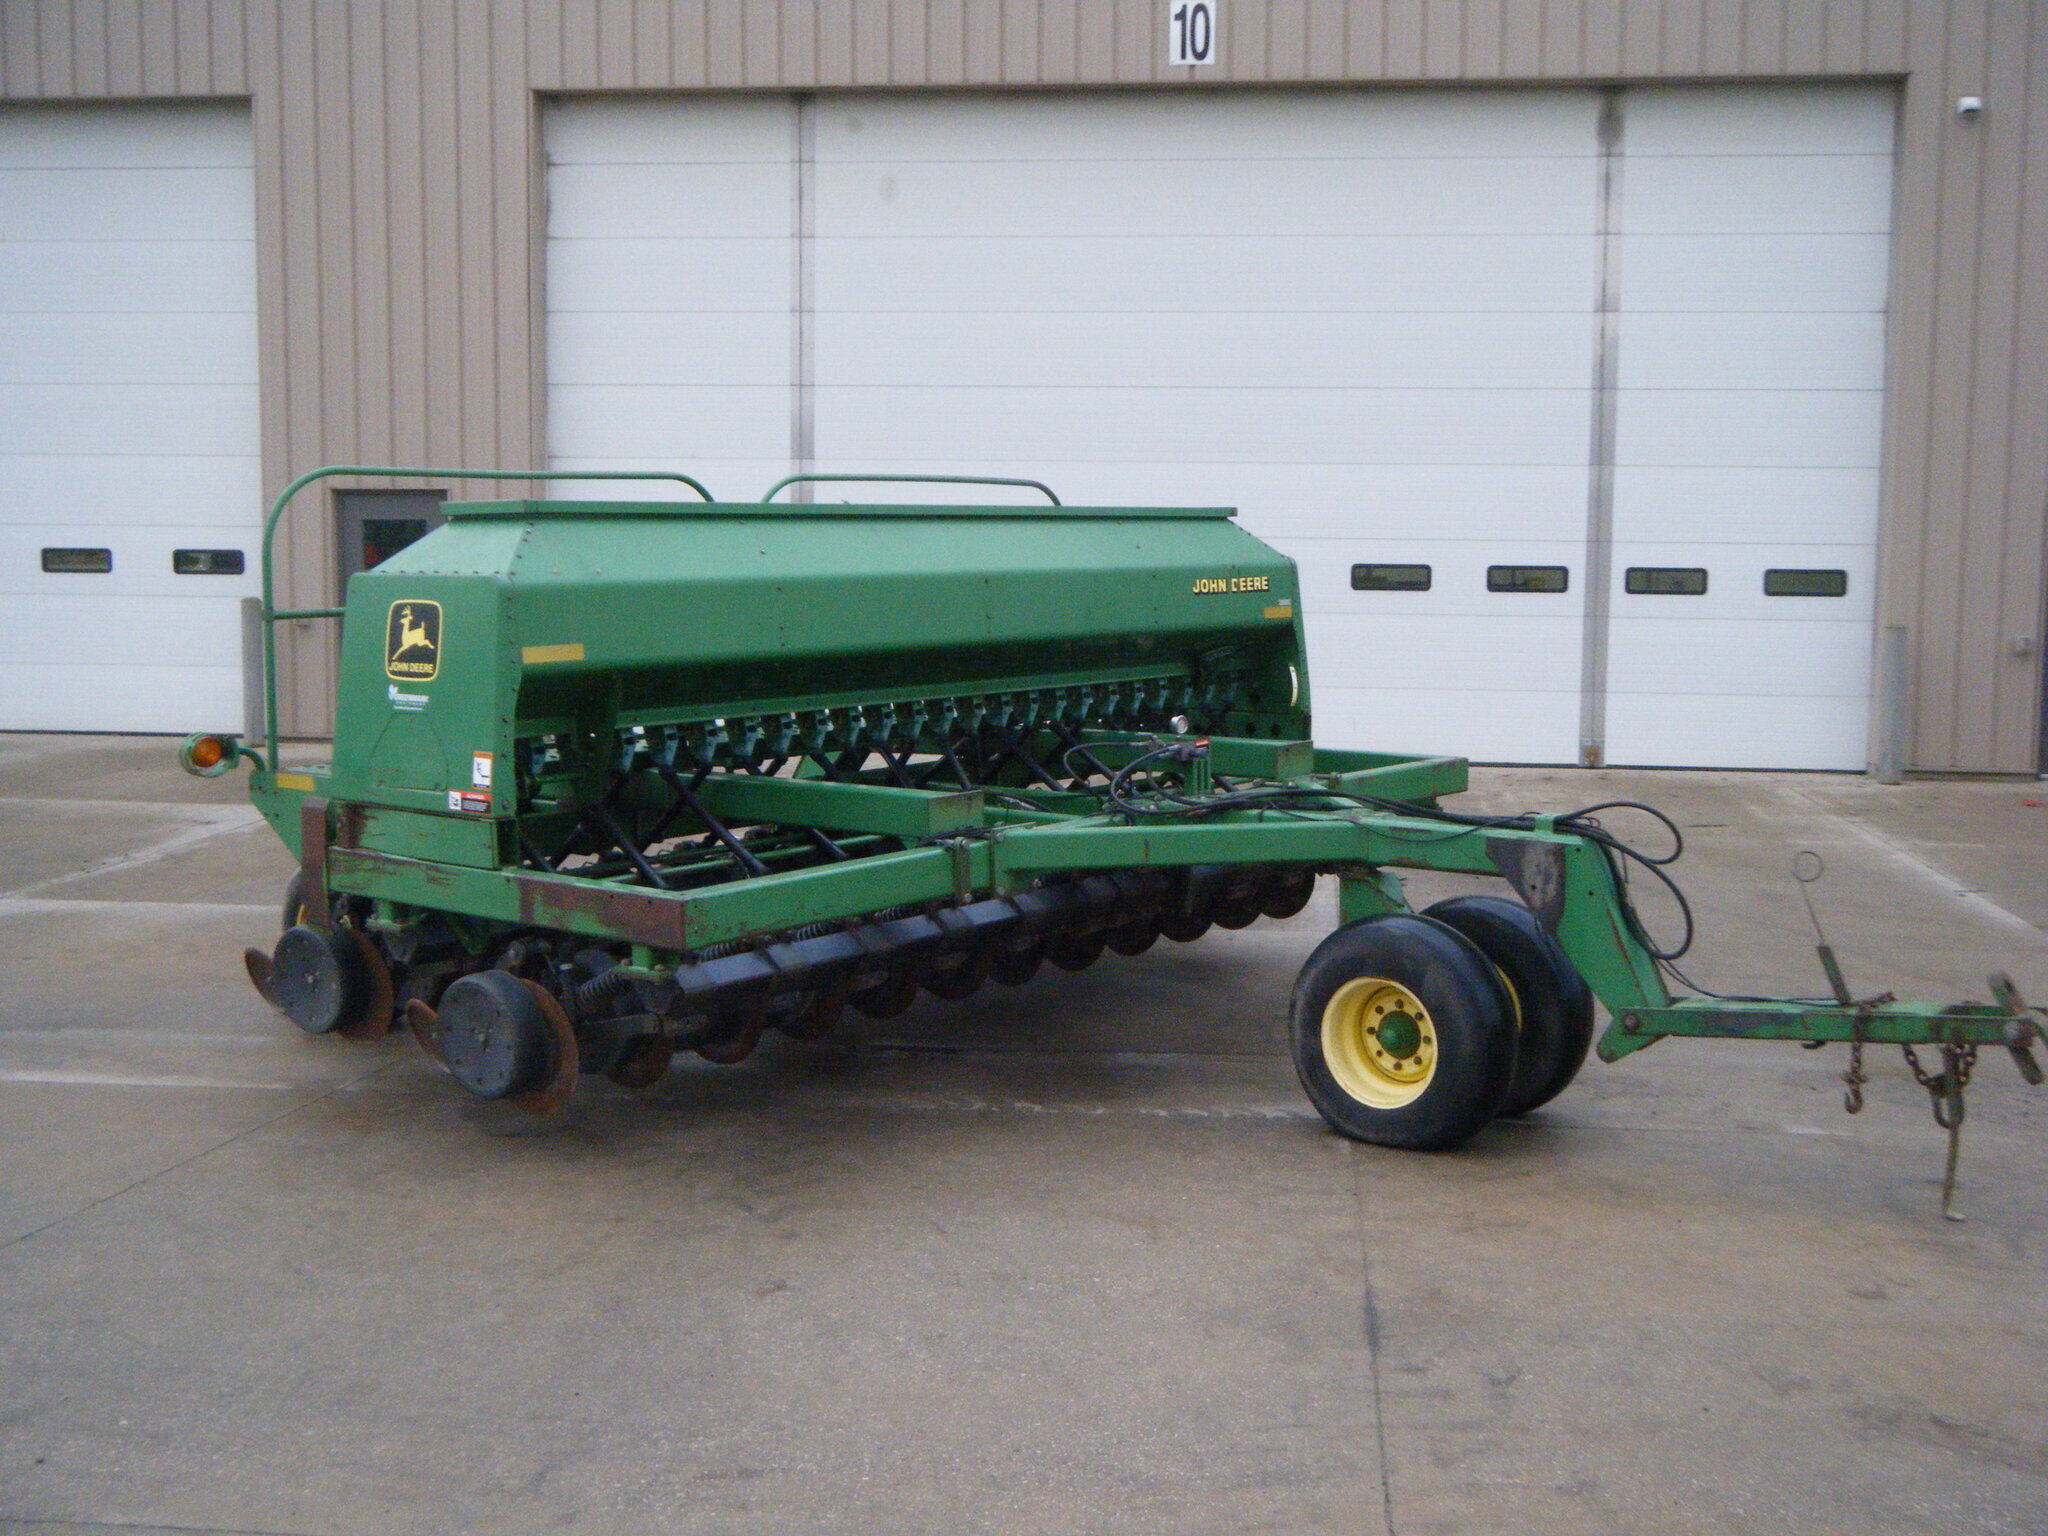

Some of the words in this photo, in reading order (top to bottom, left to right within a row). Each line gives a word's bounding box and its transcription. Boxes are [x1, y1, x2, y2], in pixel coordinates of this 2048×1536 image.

[1174, 3, 1210, 61] 10
[1192, 578, 1227, 593] JOHN
[1231, 576, 1269, 592] DEERE
[389, 661, 409, 672] JOHN
[410, 662, 434, 674] DEERE
